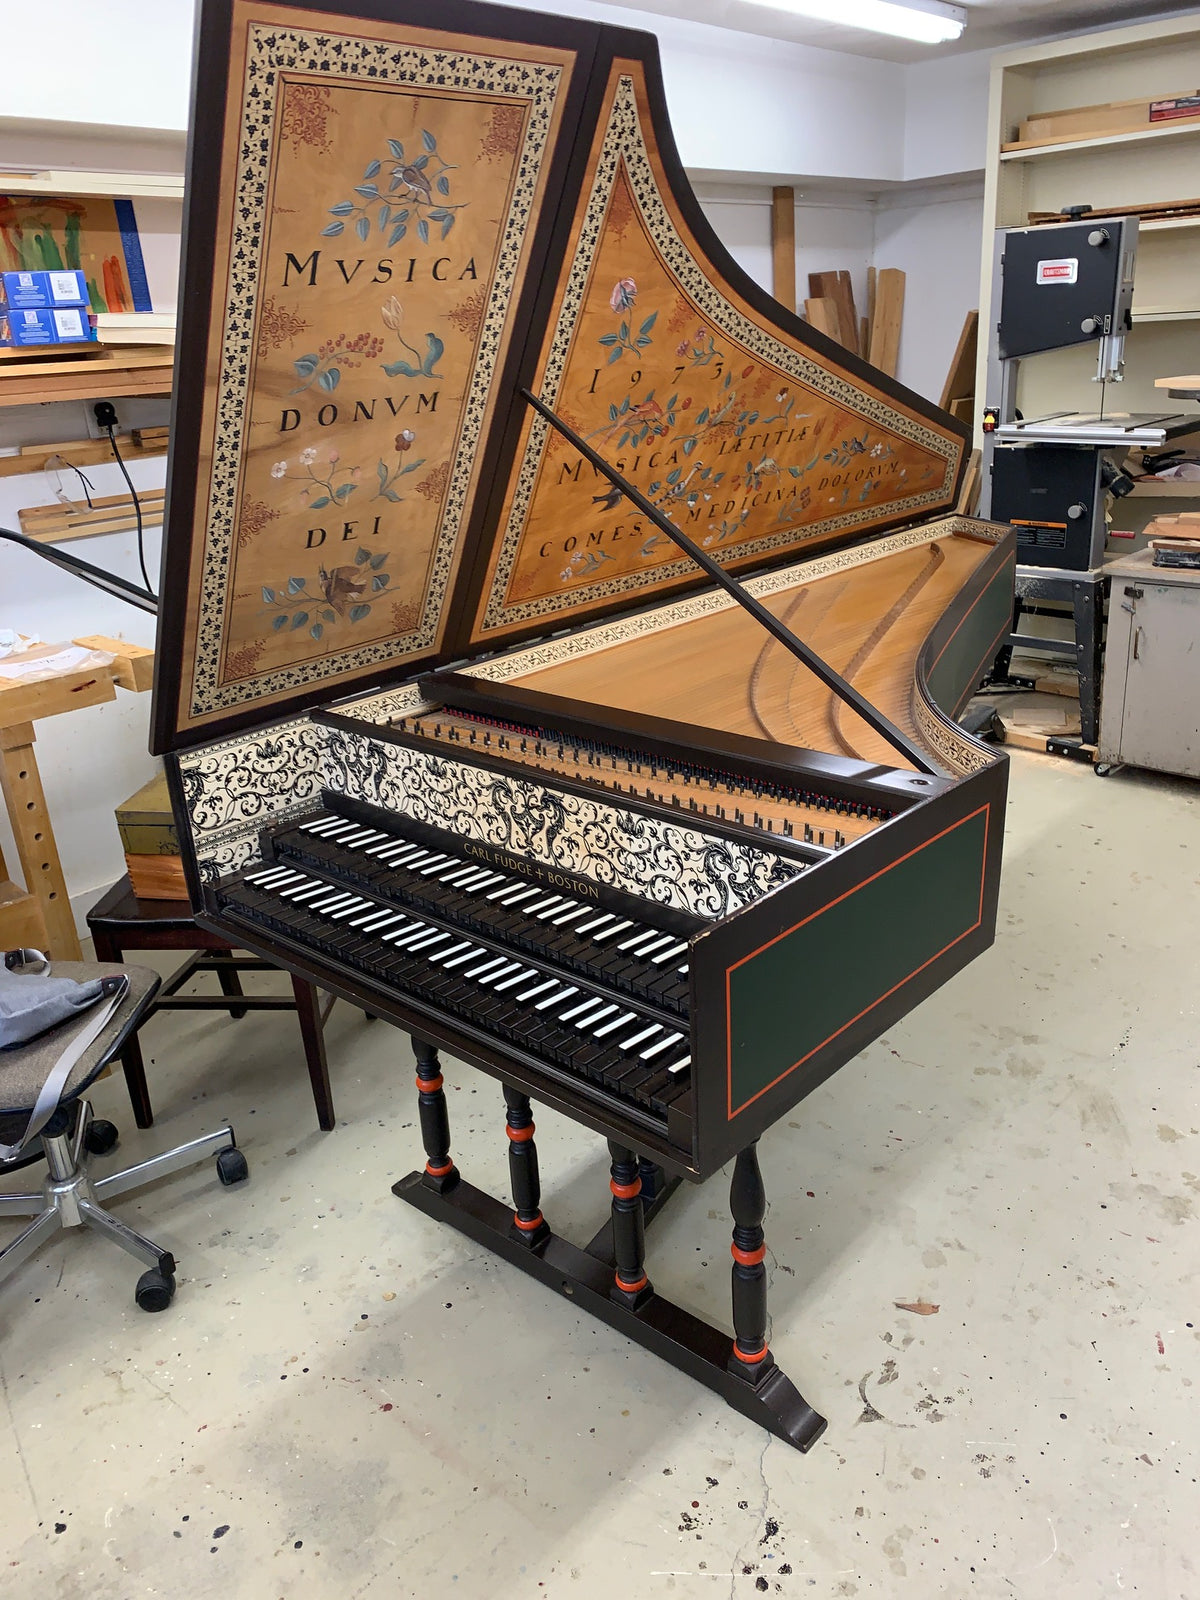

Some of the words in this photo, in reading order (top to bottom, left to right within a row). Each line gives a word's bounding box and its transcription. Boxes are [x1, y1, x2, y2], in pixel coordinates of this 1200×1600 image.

[282, 251, 479, 286] MVSICA
[280, 392, 440, 432] DONVM
[685, 485, 798, 524] MEDICINA
[304, 516, 382, 549] DEI
[463, 843, 492, 862] CARL
[494, 854, 533, 876] FUDGE
[547, 871, 600, 899] BOSTON
